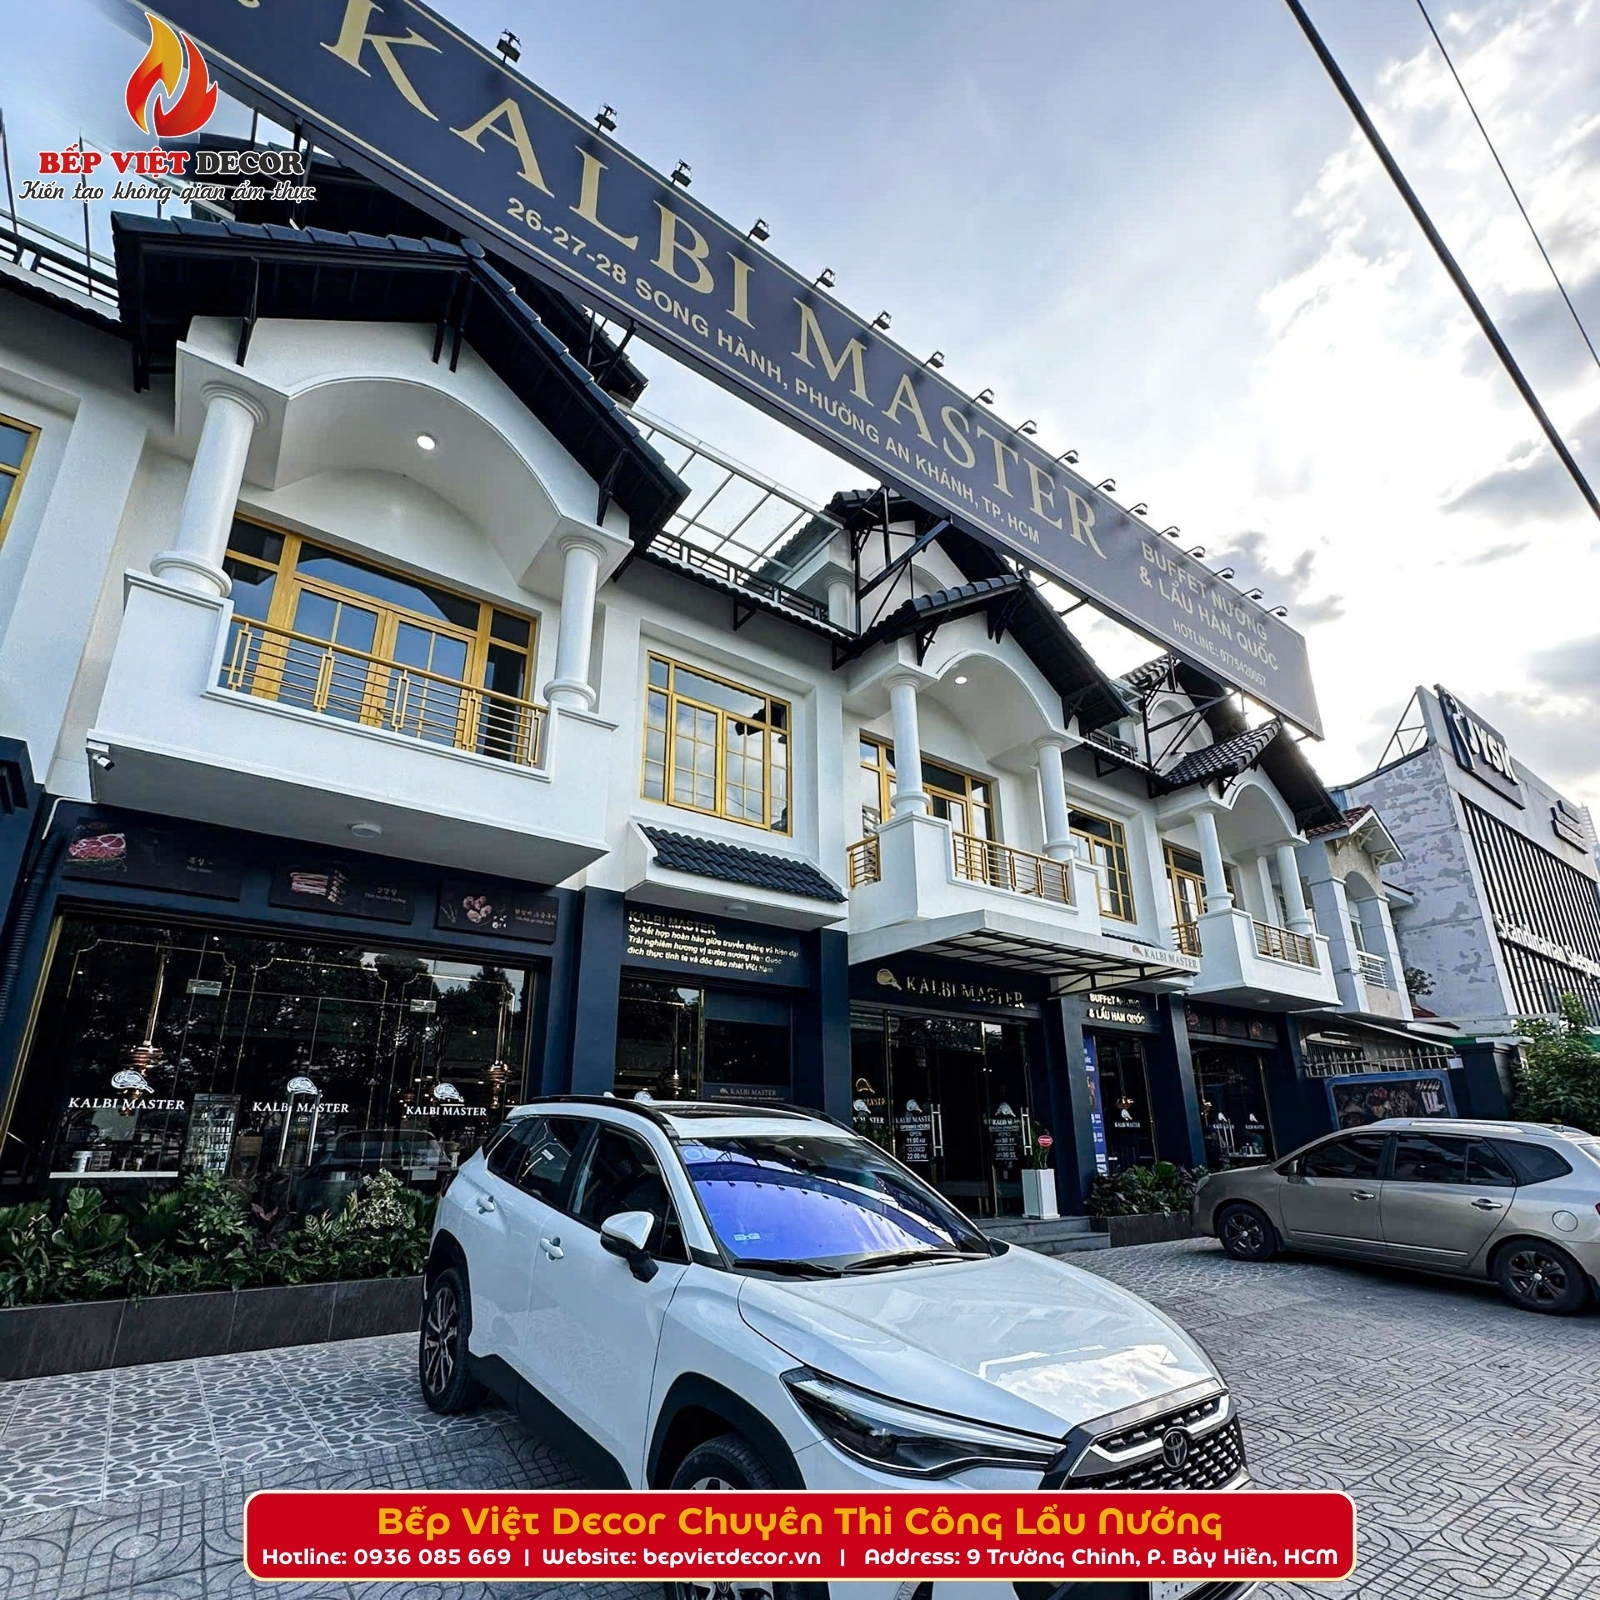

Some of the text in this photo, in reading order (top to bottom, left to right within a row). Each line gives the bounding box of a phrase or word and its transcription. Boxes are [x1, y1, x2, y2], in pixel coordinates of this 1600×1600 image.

[320, 0, 1107, 561] KALBI MASTER
[506, 197, 1041, 546] 26-27-28 SONG HÀNH, PHƯỜNG AN KHÁNH, TP. HCM
[1140, 541, 1268, 641] BUFFET NƯỚNG
[1139, 565, 1153, 588] &
[1198, 604, 1233, 641] HÀN
[1236, 631, 1279, 671] QUỐC
[1172, 617, 1219, 657] HOTLINE:
[1464, 716, 1520, 786] JYSK
[628, 910, 717, 936] KALBI MASTER
[1144, 948, 1198, 969] KALBI MASTER
[906, 976, 1026, 1009] KALBI MASTER
[1089, 993, 1116, 1006] BUFFET
[68, 1097, 185, 1110] KALBI MASTER
[252, 1101, 349, 1113] KALB MASTER
[406, 1105, 487, 1116] KALBI MASTER
